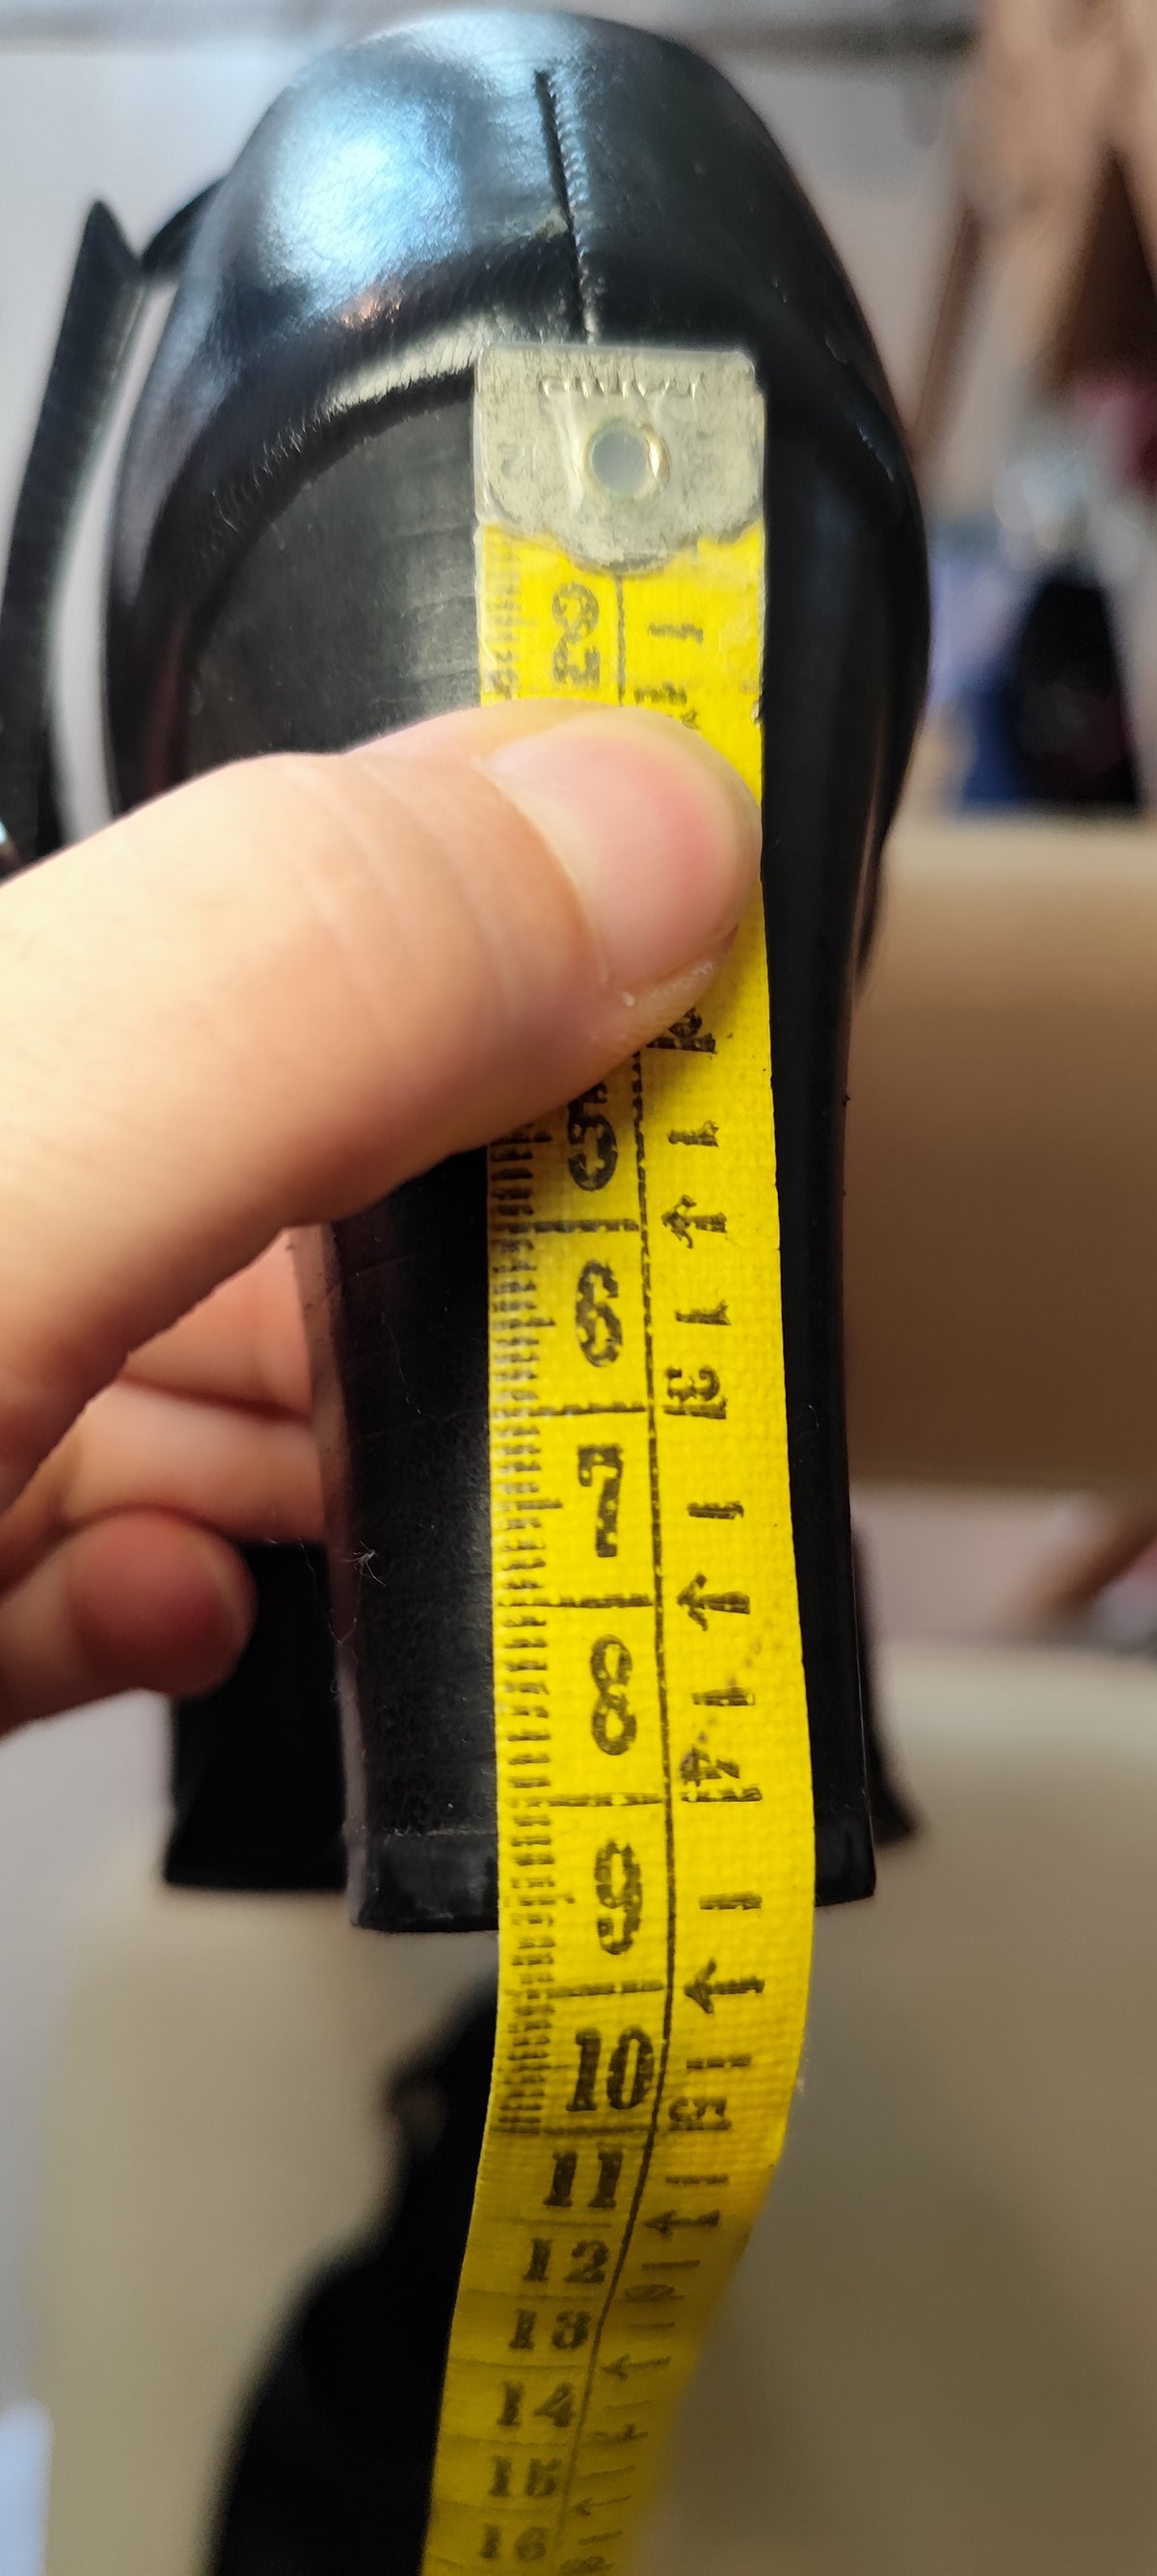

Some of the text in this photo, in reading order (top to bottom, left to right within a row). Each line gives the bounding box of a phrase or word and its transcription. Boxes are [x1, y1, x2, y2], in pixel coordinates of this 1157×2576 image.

[567, 1082, 618, 1192] 5
[575, 1259, 623, 1368] 6
[578, 1445, 624, 1558] 7
[589, 1634, 637, 1755] 8
[593, 1838, 643, 1956] 9
[565, 2026, 655, 2112] 10
[542, 2150, 624, 2209] 11
[523, 2238, 609, 2285] 12
[508, 2309, 592, 2350] 13
[496, 2380, 576, 2428] 14
[488, 2456, 562, 2498] 15
[479, 2523, 549, 2561] 16
